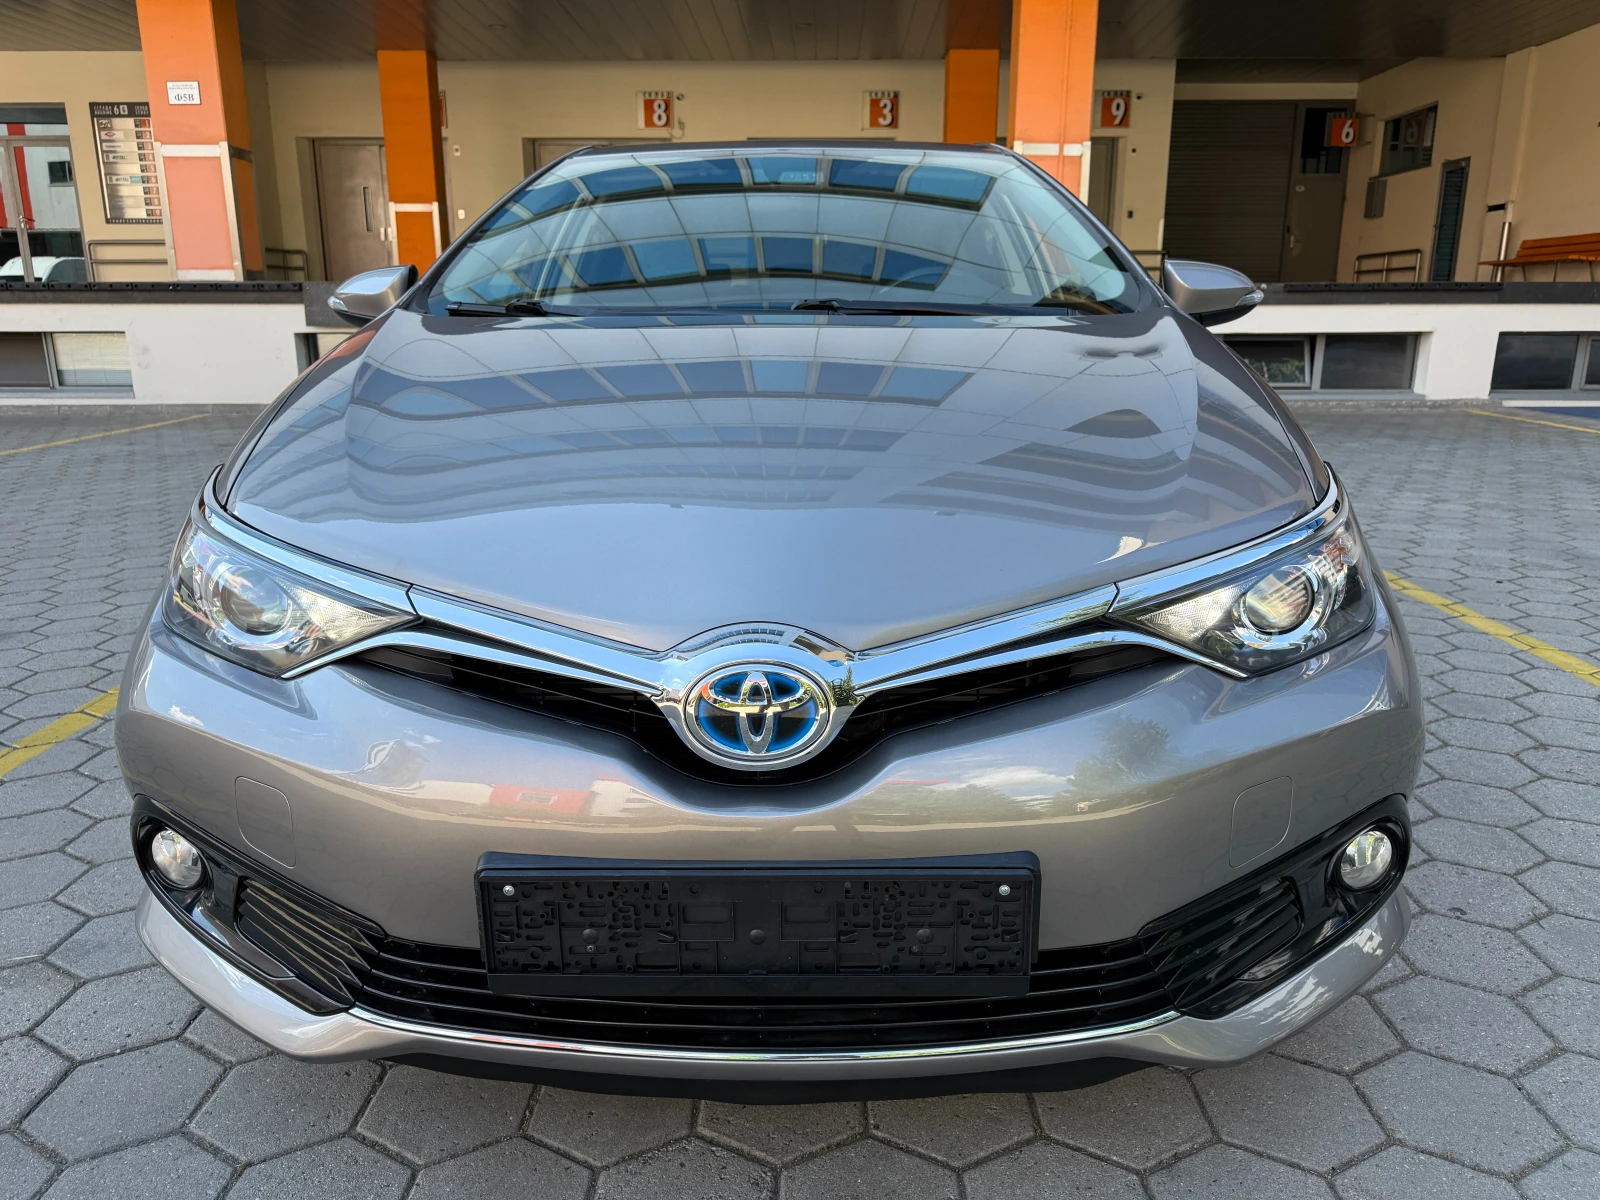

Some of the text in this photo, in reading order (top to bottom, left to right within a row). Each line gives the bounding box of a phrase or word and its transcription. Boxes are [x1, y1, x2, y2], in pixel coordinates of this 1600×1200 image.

[113, 104, 120, 115] 6
[652, 99, 668, 127] 8
[878, 99, 893, 126] 3
[1111, 98, 1126, 125] 9
[1341, 120, 1355, 144] 6
